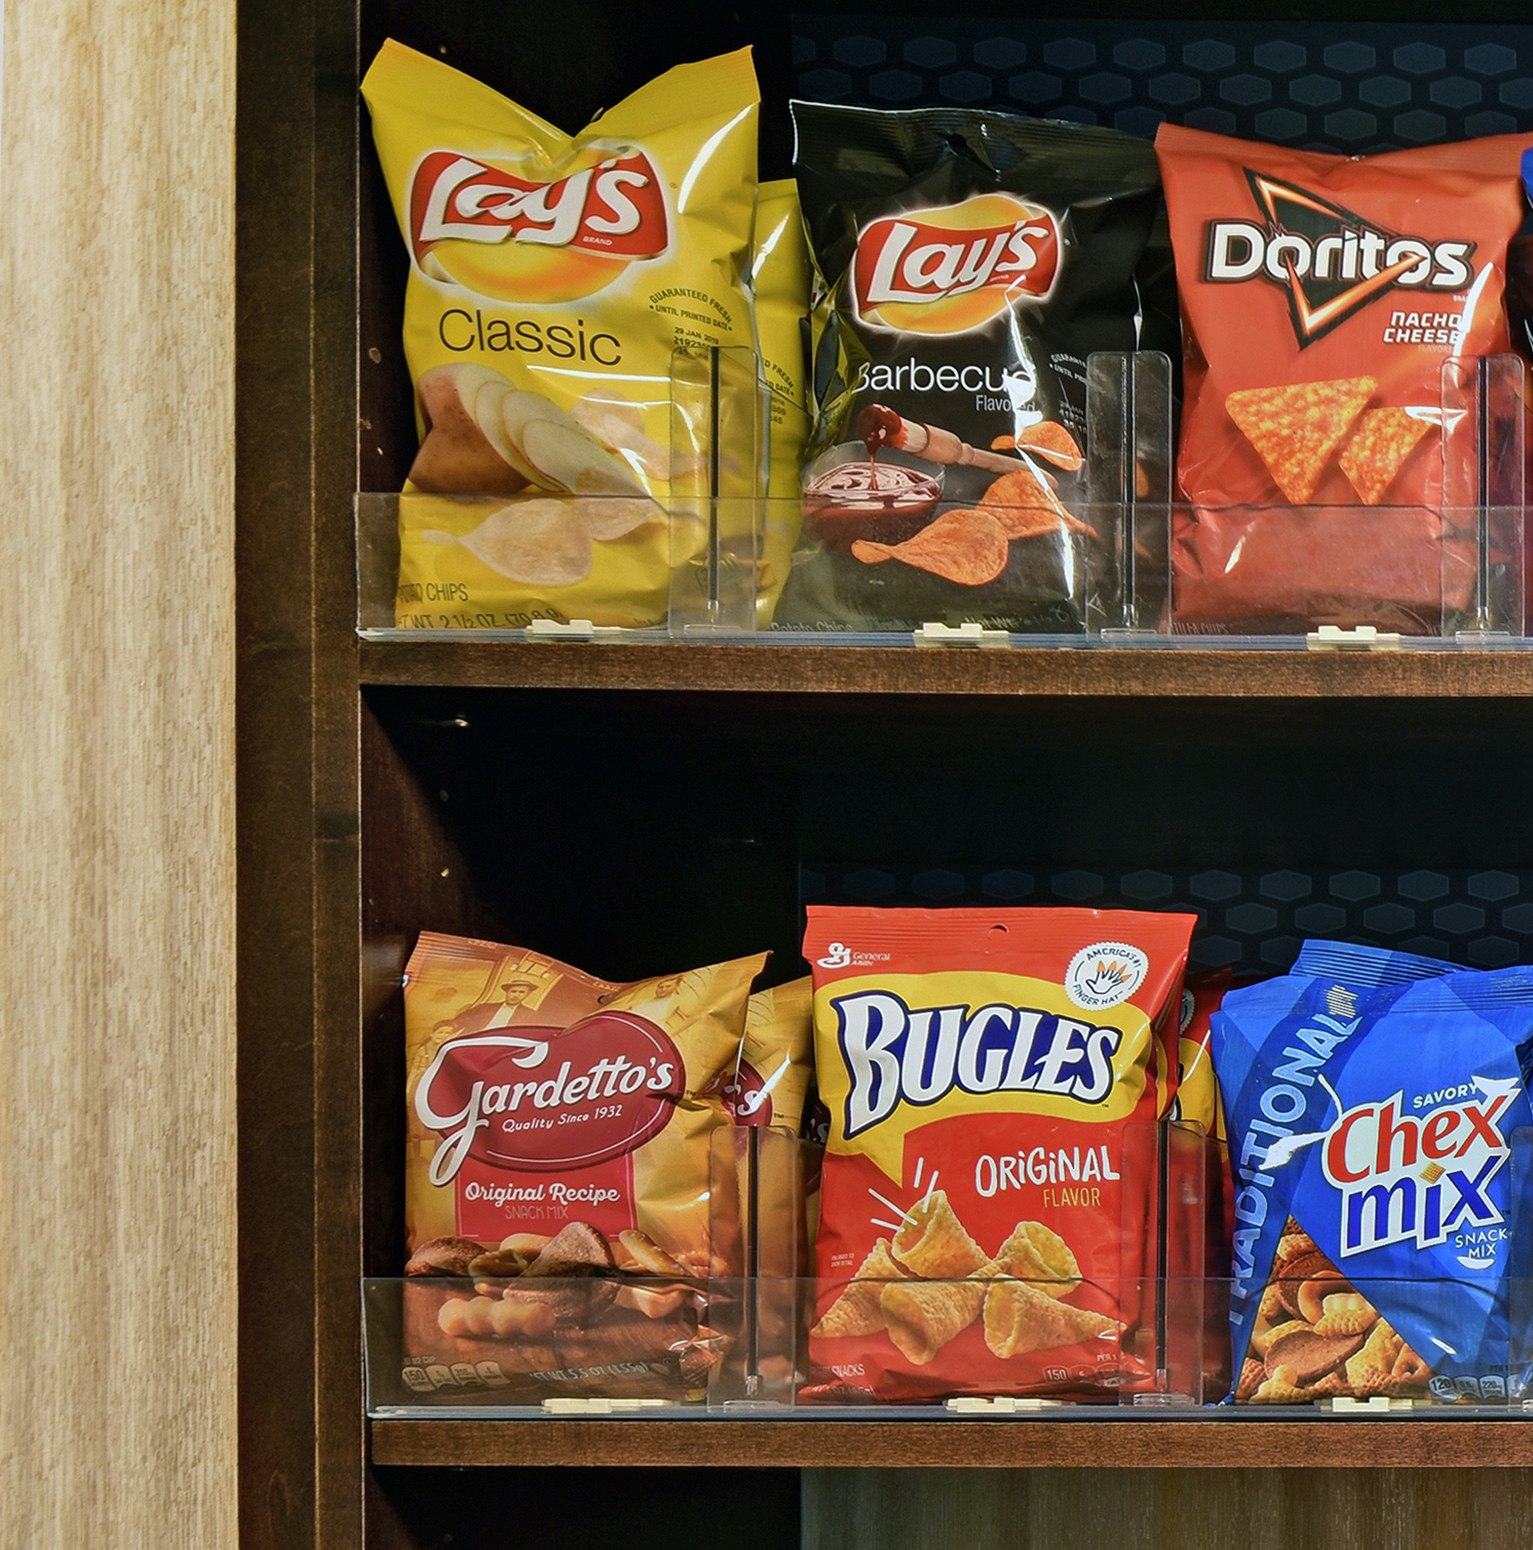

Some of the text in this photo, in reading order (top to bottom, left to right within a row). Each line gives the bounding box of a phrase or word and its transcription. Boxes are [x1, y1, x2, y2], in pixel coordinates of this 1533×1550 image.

[420, 157, 650, 246] Lay's
[867, 220, 1049, 303] Lay's
[1210, 222, 1469, 285] Doritos
[650, 288, 733, 324] GUARANTEED FRESH
[439, 308, 623, 367] Classic
[426, 584, 468, 601] CHIPS
[840, 993, 1121, 1138] BUGLES
[416, 1036, 674, 1187] Gardetto's
[502, 1105, 622, 1133] Quality Since 1932
[1413, 1083, 1477, 1108] SAVORY
[1327, 1096, 1507, 1183] Chex
[465, 1182, 620, 1206] Original Recipe
[1043, 1188, 1100, 1208] FLAVOR
